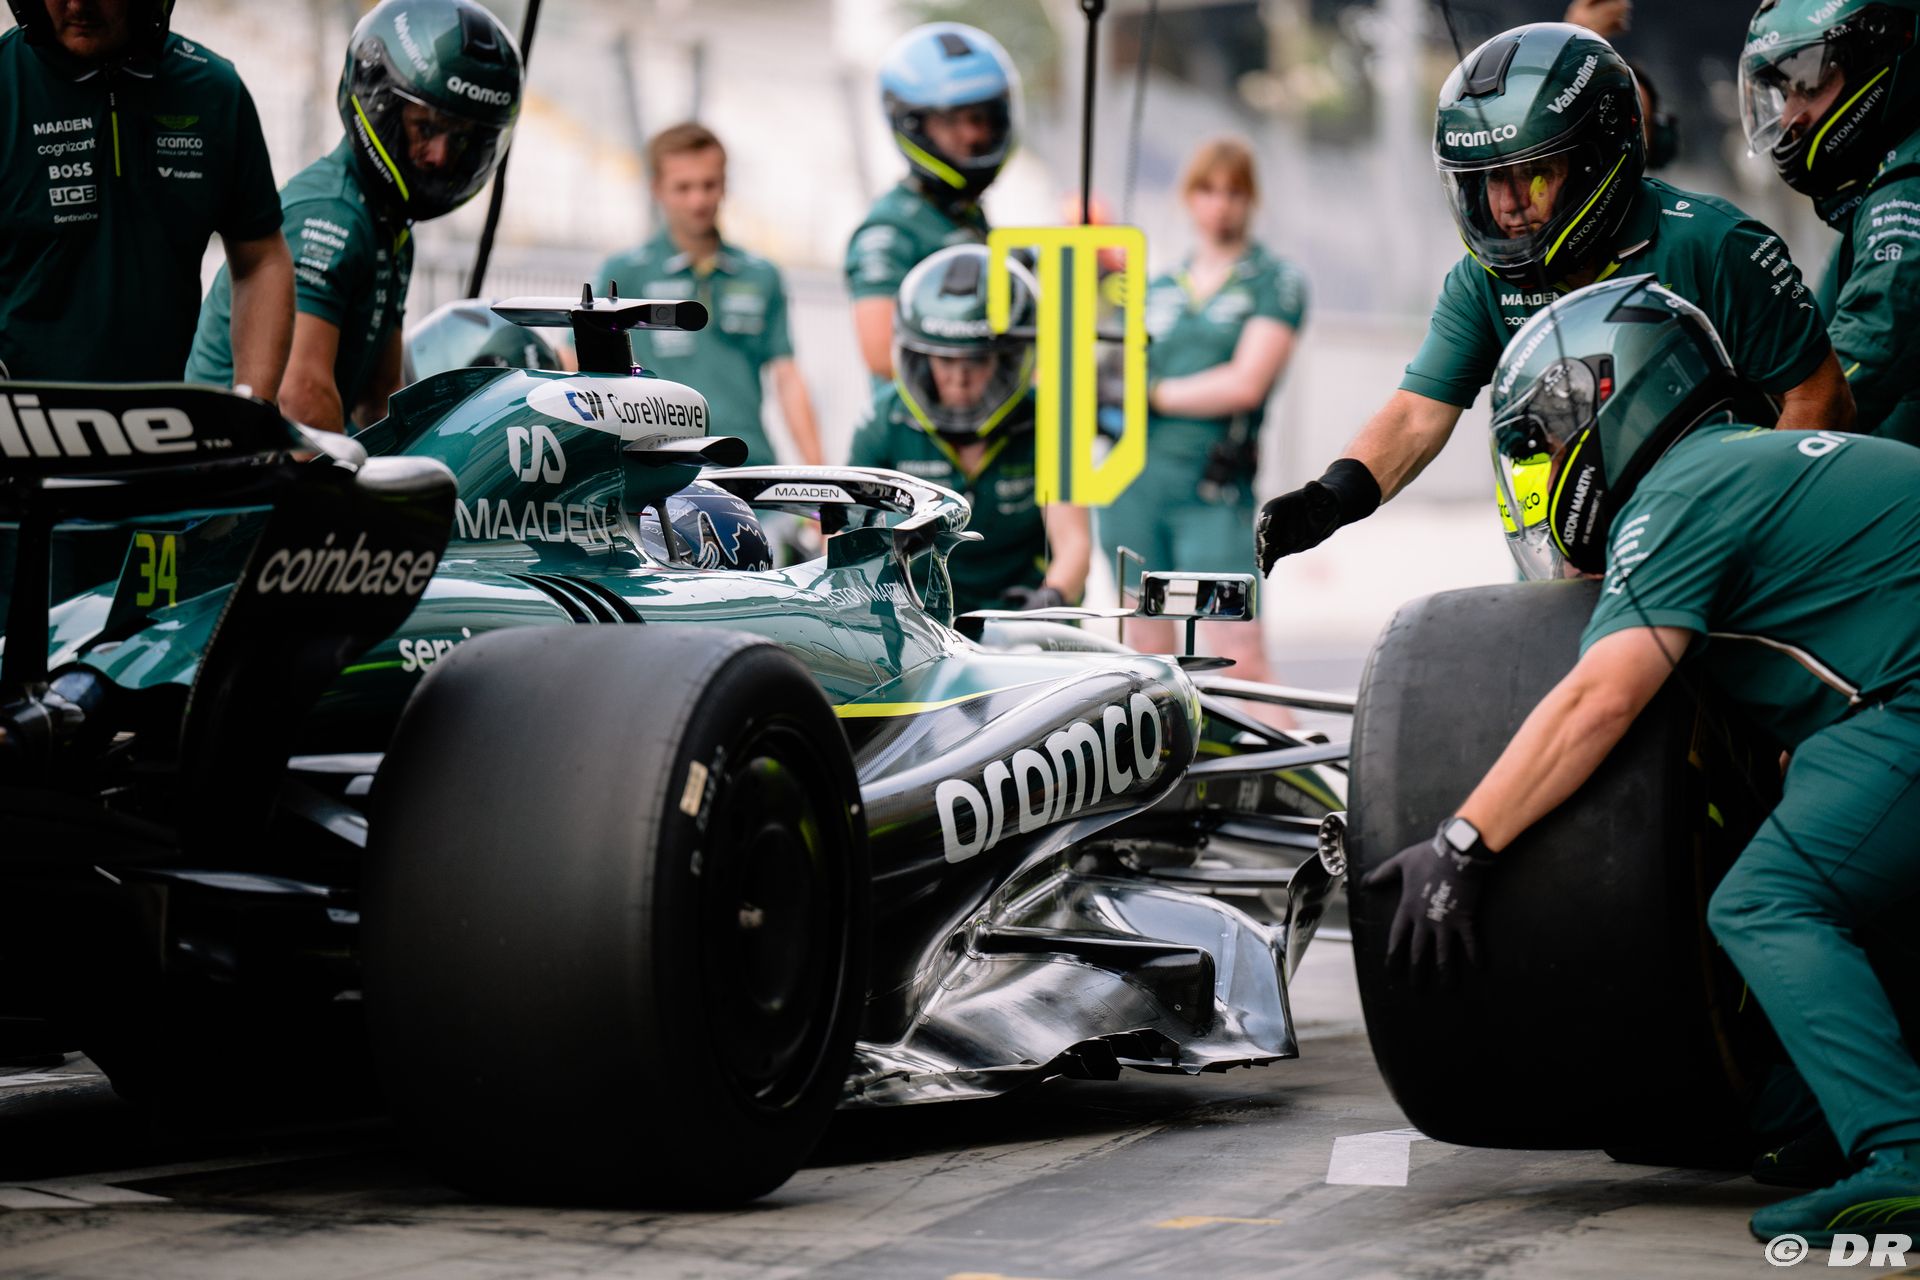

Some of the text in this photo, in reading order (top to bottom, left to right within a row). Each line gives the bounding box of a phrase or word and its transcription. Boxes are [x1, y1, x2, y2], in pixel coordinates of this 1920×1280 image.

[447, 76, 511, 106] aramco
[33, 117, 93, 135] MAADEN
[1824, 85, 1885, 153] ASTON MARTIN
[37, 138, 96, 157] cognizant
[156, 137, 203, 149] aramco
[1445, 124, 1518, 148] aramco
[49, 162, 93, 180] BOSS
[50, 185, 97, 206] JCB
[1568, 216, 1597, 250] ASTON
[1595, 176, 1621, 218] MARTIN
[1873, 243, 1903, 261] citi
[607, 393, 703, 429] CoreWeave
[774, 487, 840, 498] MAADEN
[1570, 463, 1596, 513] MARTIN
[454, 498, 614, 545] MAADEN
[1563, 510, 1581, 546] ASTON
[135, 533, 177, 608] 34
[257, 532, 437, 596] coinbase
[826, 582, 911, 607] ASTON MARTIN
[935, 692, 1163, 865] aramco
